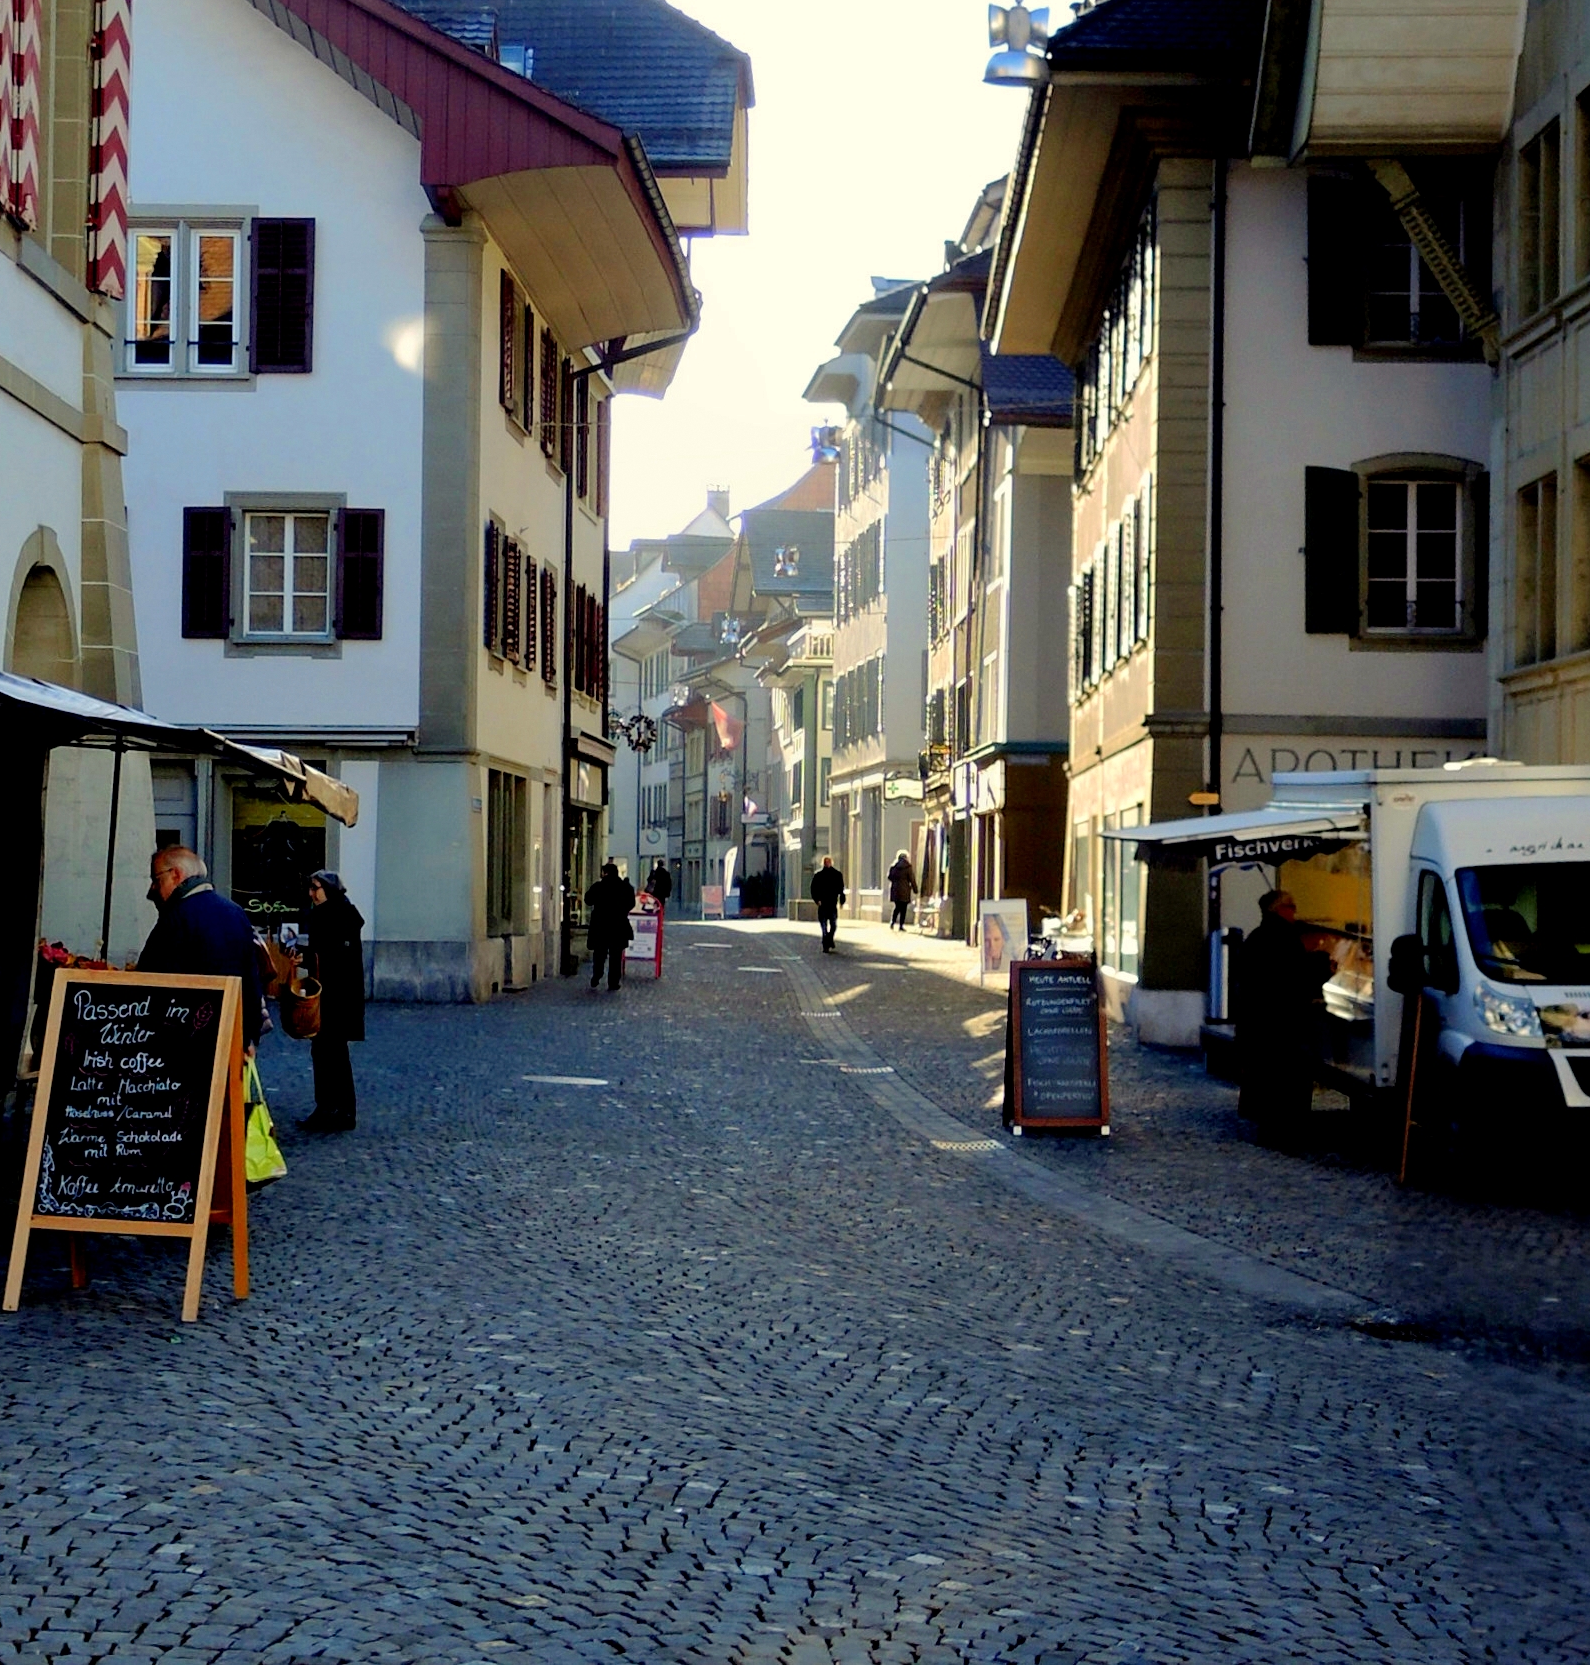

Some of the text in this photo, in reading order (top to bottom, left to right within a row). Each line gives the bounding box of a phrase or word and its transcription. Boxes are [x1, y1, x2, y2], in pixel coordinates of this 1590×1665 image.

[1232, 747, 1488, 783] APOTHE
[73, 989, 191, 1024] Passend im
[99, 1022, 156, 1045] Winter
[82, 1049, 165, 1074] Irish coffee
[70, 1075, 182, 1097] Latte Macchiato
[96, 1091, 123, 1106] mit
[57, 1126, 183, 1146] Warme Schokolade
[84, 1143, 143, 1158] mit Rum
[56, 1174, 100, 1201] Kaffee
